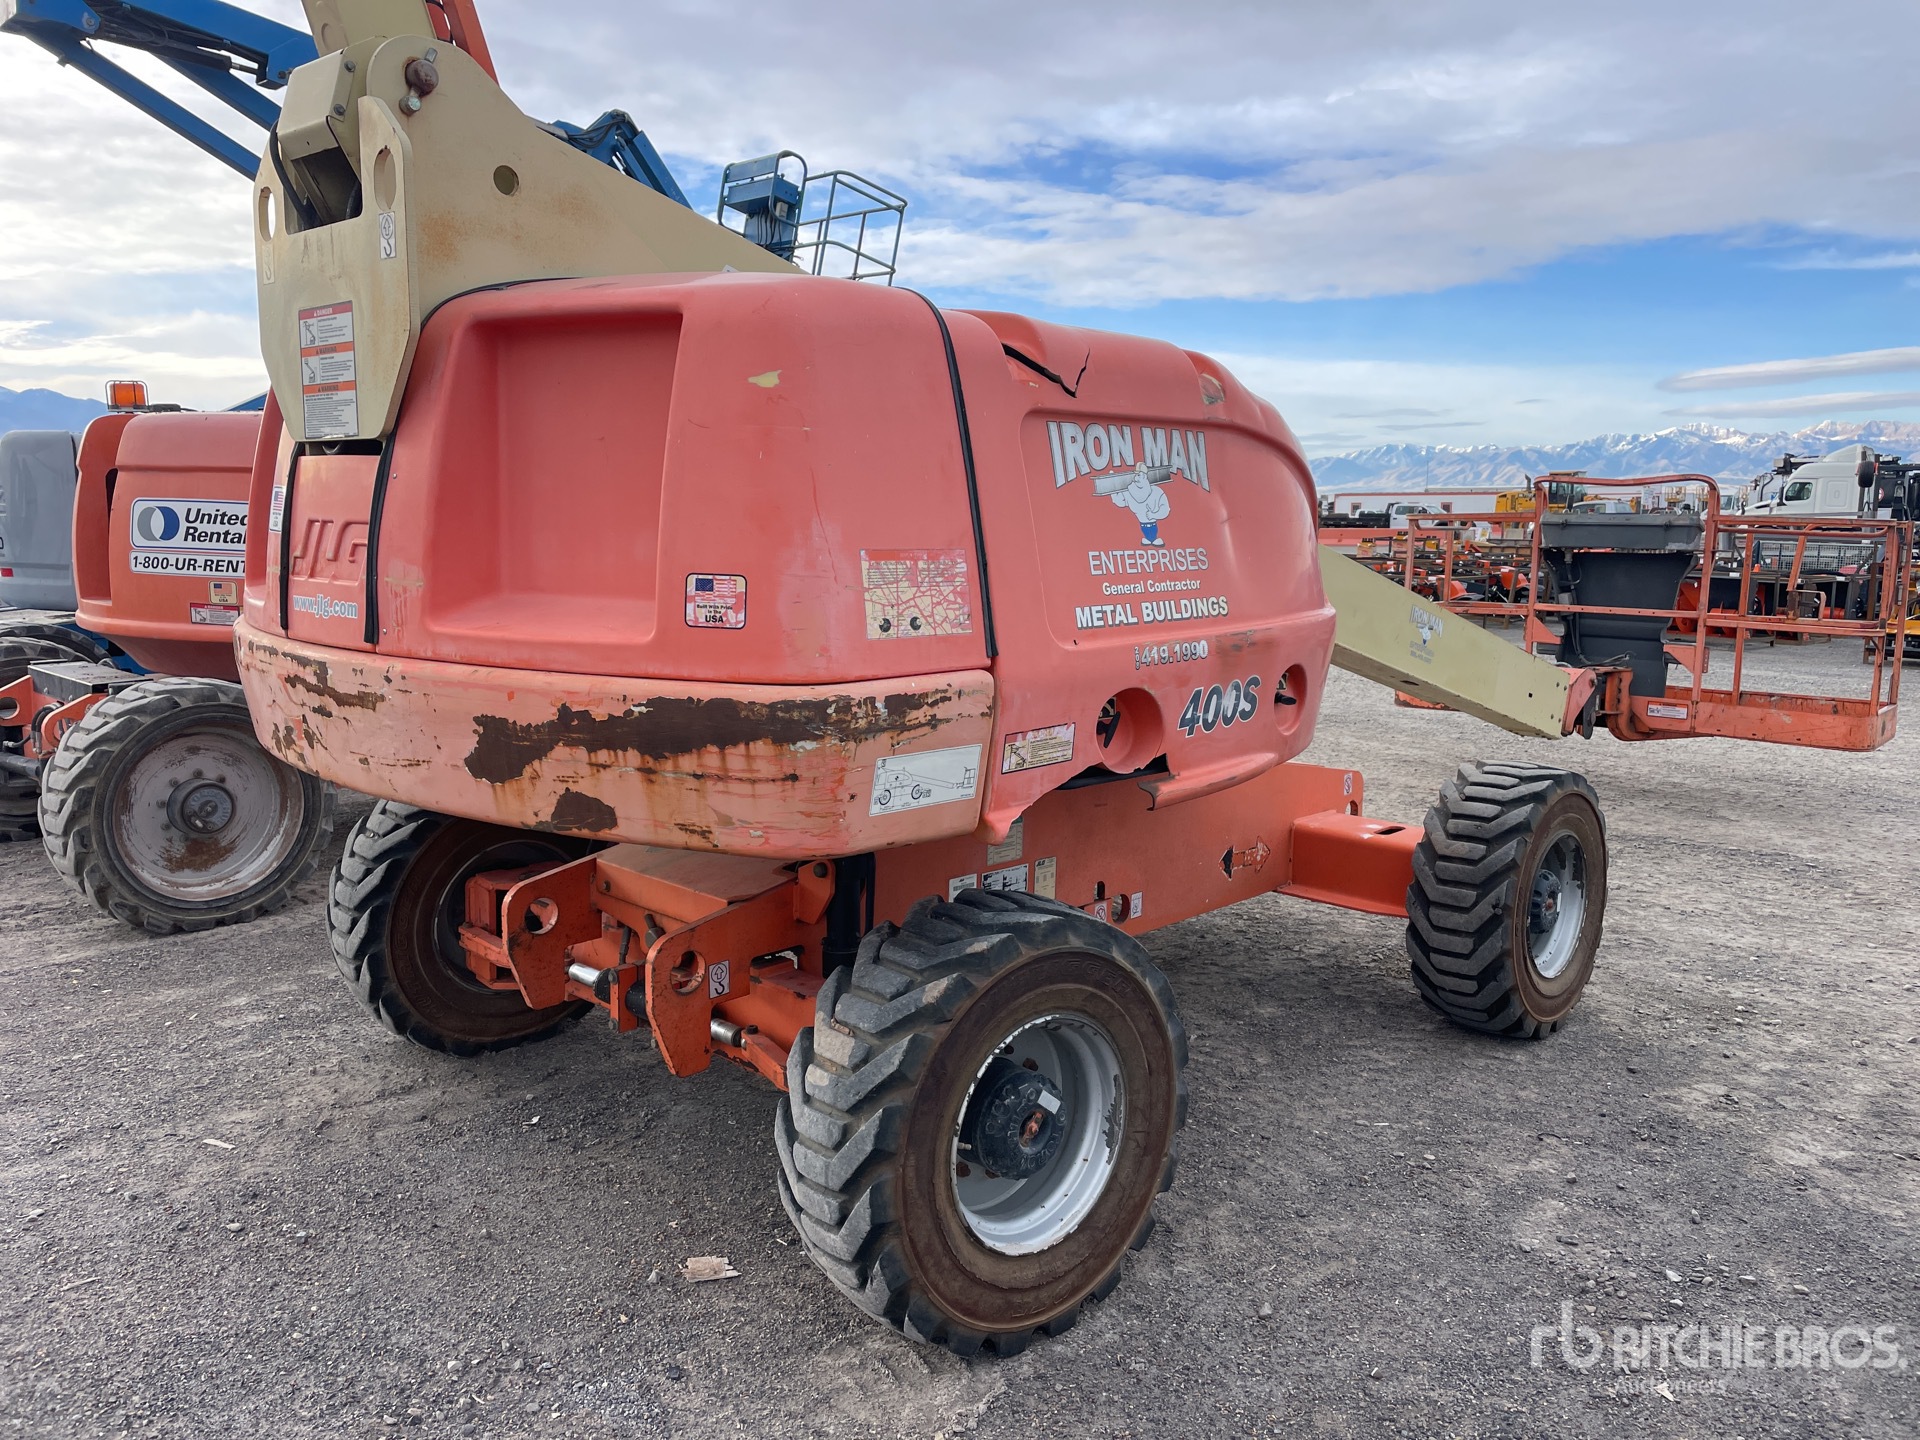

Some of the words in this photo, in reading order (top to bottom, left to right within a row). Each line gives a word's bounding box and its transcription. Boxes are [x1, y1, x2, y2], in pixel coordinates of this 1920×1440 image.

[1046, 421, 1135, 489] IRON
[1140, 426, 1211, 493] MAN
[1088, 547, 1209, 576] ENTERPRISES
[1102, 580, 1145, 596] General
[1147, 577, 1201, 593] Contractor
[293, 594, 358, 619] www.jlg.com
[705, 615, 724, 623] USA
[1075, 603, 1139, 630] METAL
[1141, 596, 1229, 623] BUILDINGS
[1410, 605, 1428, 624] IRON
[1141, 639, 1209, 668] 419.1990
[1177, 674, 1262, 738] 400S
